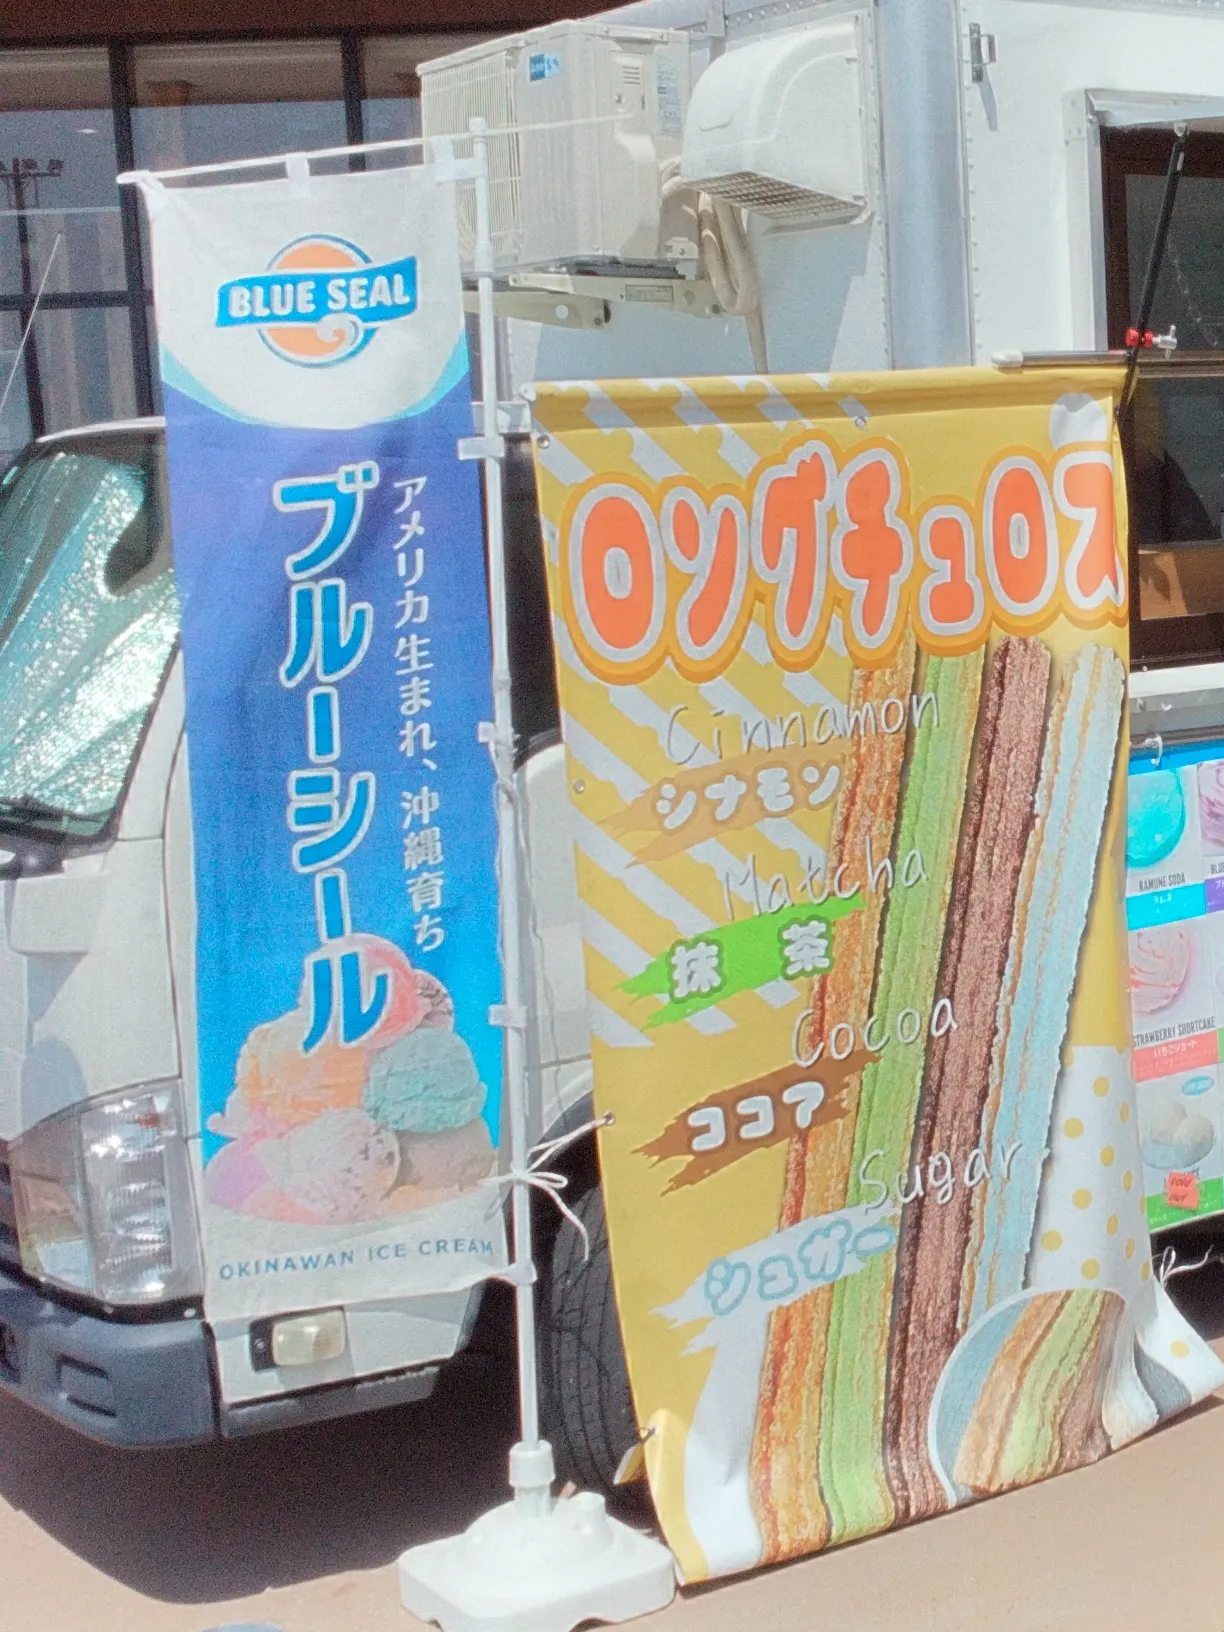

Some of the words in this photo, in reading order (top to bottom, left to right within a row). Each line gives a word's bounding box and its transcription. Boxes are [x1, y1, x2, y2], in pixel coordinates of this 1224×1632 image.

[229, 281, 315, 318] BLUE
[327, 273, 410, 312] SEAL
[568, 440, 1125, 662] ロングチュロス
[392, 475, 446, 954] アメリカ生まれ、沖縄育ち
[667, 690, 940, 764] Cinnamon
[273, 461, 391, 1054] ブルーシール
[656, 762, 841, 830] シナモン
[724, 835, 929, 920] Matcha
[1139, 876, 1167, 892] RAMUNE
[1167, 872, 1186, 886] SODA
[670, 920, 830, 999] 抹茶
[792, 997, 958, 1068] Cocoa
[1154, 1039, 1198, 1057] いちごショート
[1178, 1016, 1217, 1037] SHORTCAKE
[687, 1081, 825, 1152] ココア
[858, 1139, 1024, 1216] Sugar
[218, 1250, 355, 1281] OKINAWAN
[368, 1243, 408, 1263] ICE
[418, 1237, 495, 1257] CREAM
[703, 1217, 897, 1317] シュガー
